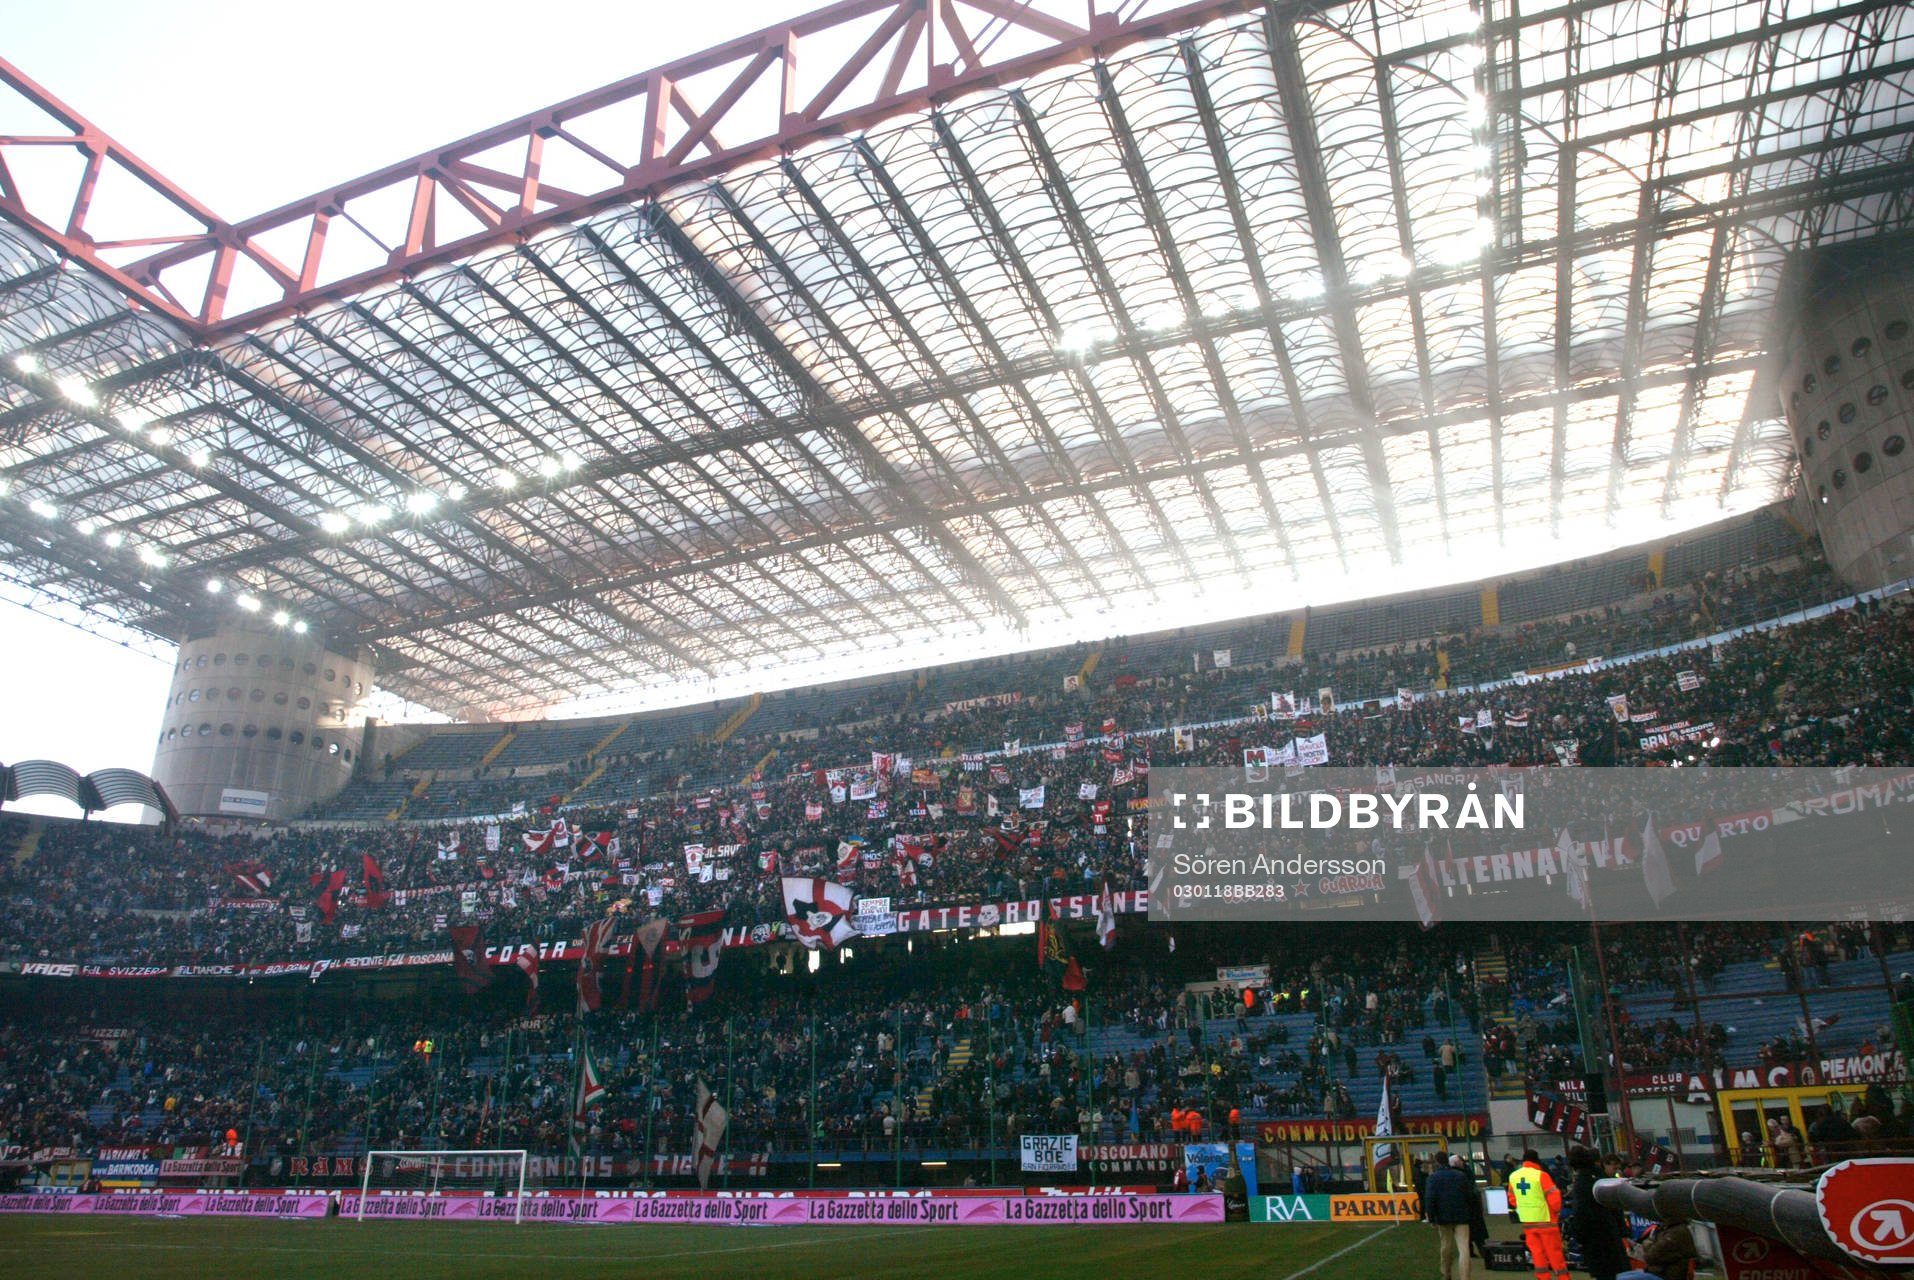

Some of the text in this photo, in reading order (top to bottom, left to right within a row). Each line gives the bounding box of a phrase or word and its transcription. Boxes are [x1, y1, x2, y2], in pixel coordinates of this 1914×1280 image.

[1670, 815, 1770, 847] QURTO
[898, 905, 973, 932] GATE
[1558, 1080, 1585, 1091] MILA
[1651, 1072, 1682, 1085] CLUB
[1023, 1136, 1072, 1151] GRAZIE
[455, 1154, 735, 1178] COMMANDOS TIGE
[340, 1199, 447, 1216] La Gzzetta dello Sport
[479, 1200, 598, 1220] La Gazztta dello Sport
[635, 1200, 768, 1220] La Gazzetta dello Sport
[810, 1200, 959, 1222] La Gazzetta dello Sport
[1006, 1197, 1173, 1223] La Gazzetta dello Sport
[1493, 1254, 1514, 1263] TELE
